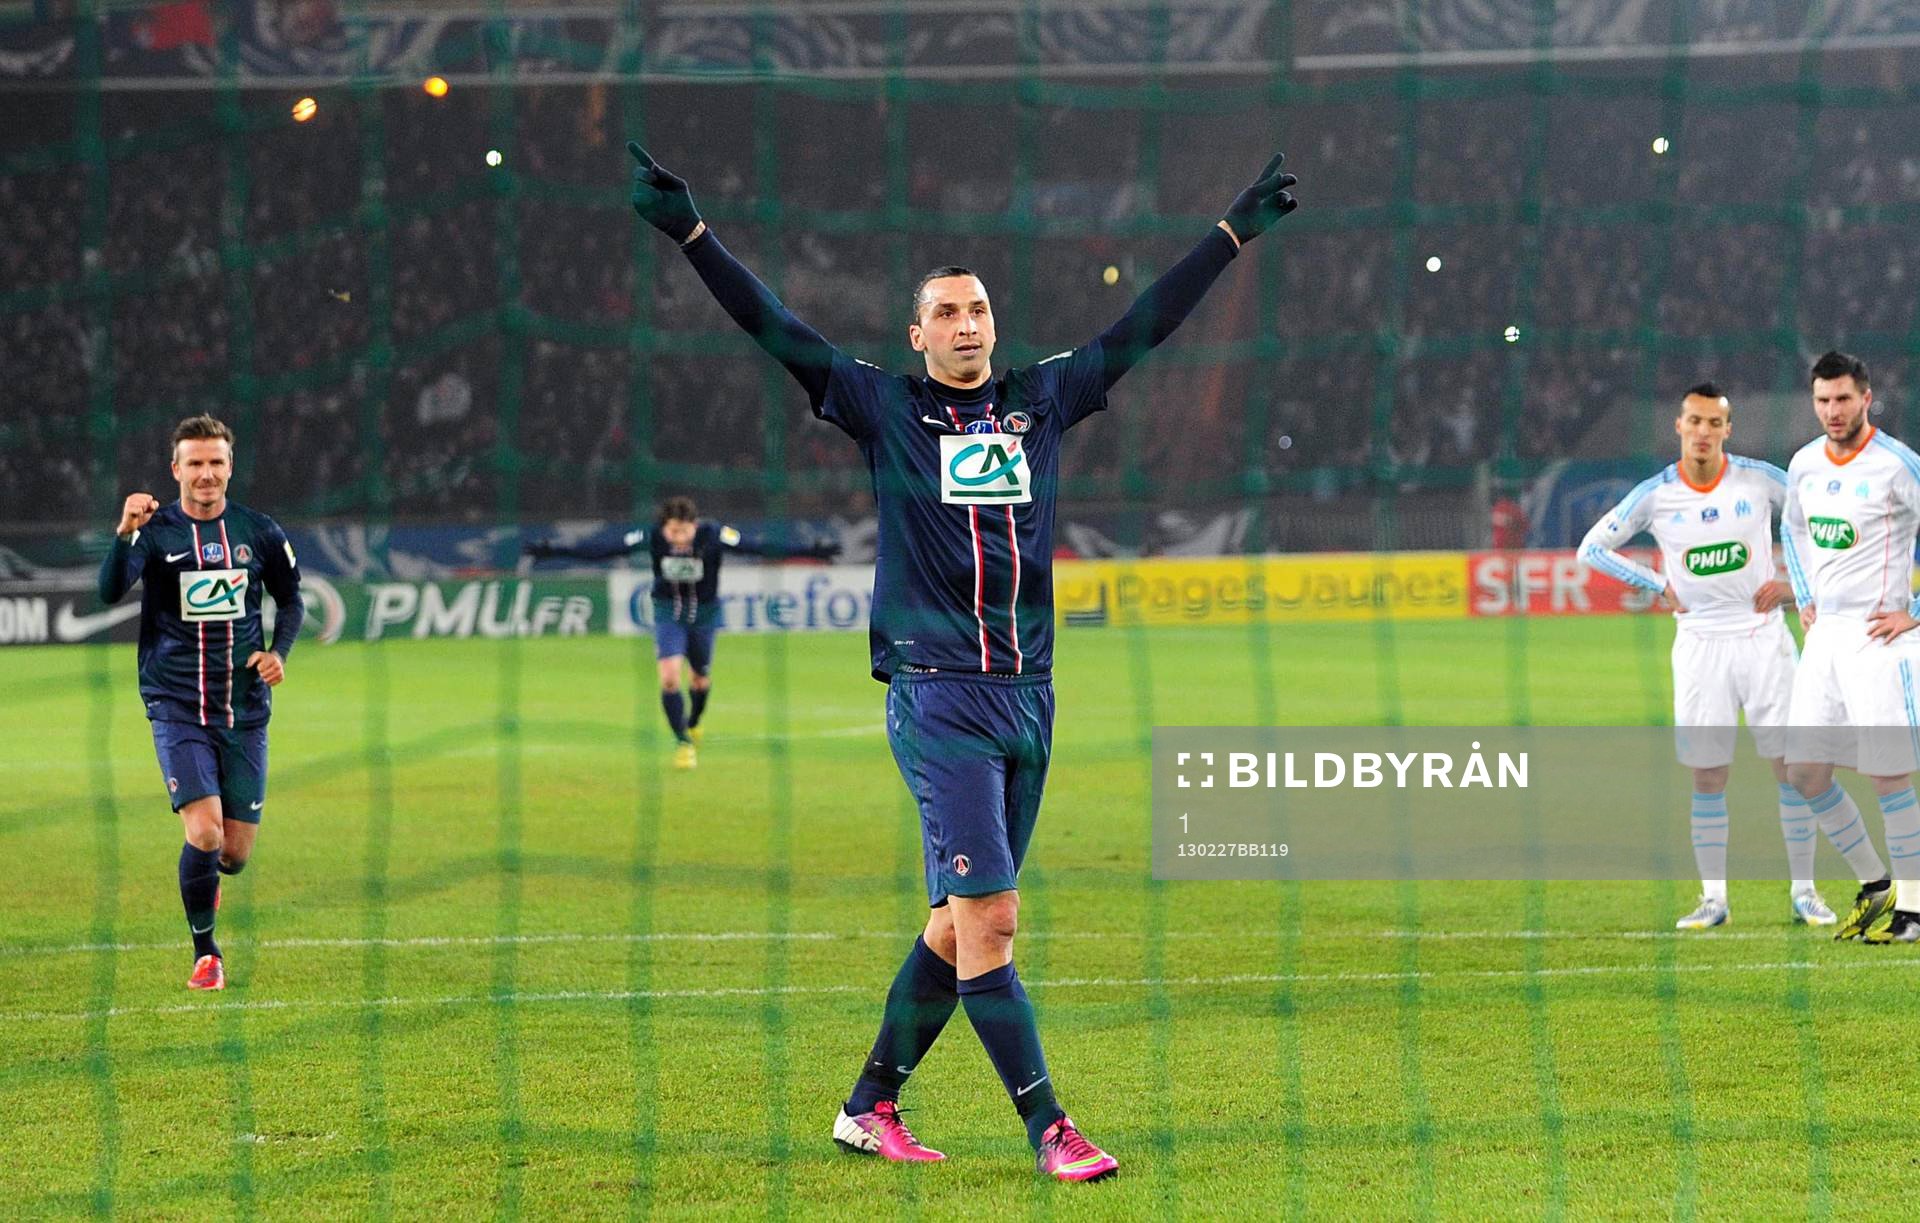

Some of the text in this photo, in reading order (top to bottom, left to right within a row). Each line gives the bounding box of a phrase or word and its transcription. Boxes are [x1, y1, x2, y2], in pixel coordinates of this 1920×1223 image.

[1475, 555, 1591, 612] SFR
[1689, 548, 1727, 571] PMU
[366, 581, 593, 640] PMU.FR
